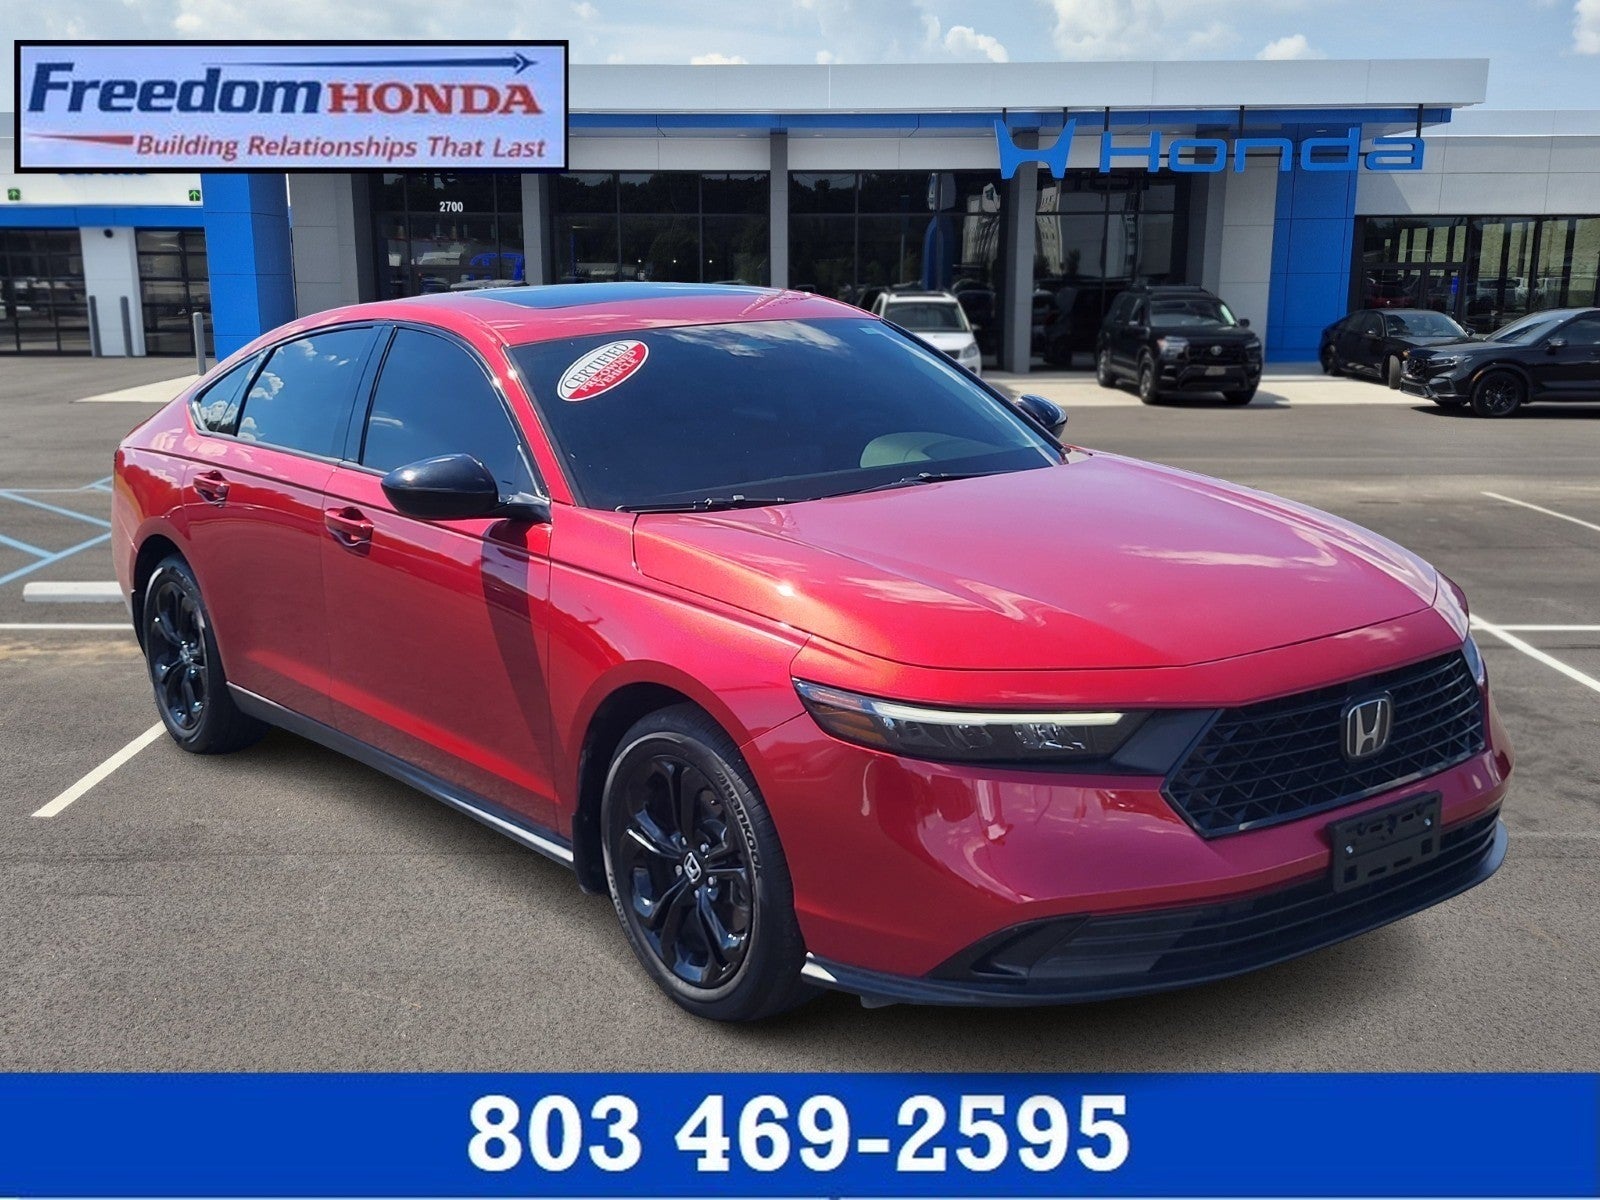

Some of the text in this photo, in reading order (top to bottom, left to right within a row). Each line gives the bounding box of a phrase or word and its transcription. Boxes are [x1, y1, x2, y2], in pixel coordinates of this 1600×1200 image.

[1100, 127, 1425, 173] Honda
[439, 201, 464, 212] 2700
[564, 342, 630, 390] CERTIFIED
[580, 349, 637, 392] PRE-OWNED
[595, 357, 639, 388] VEHICLE
